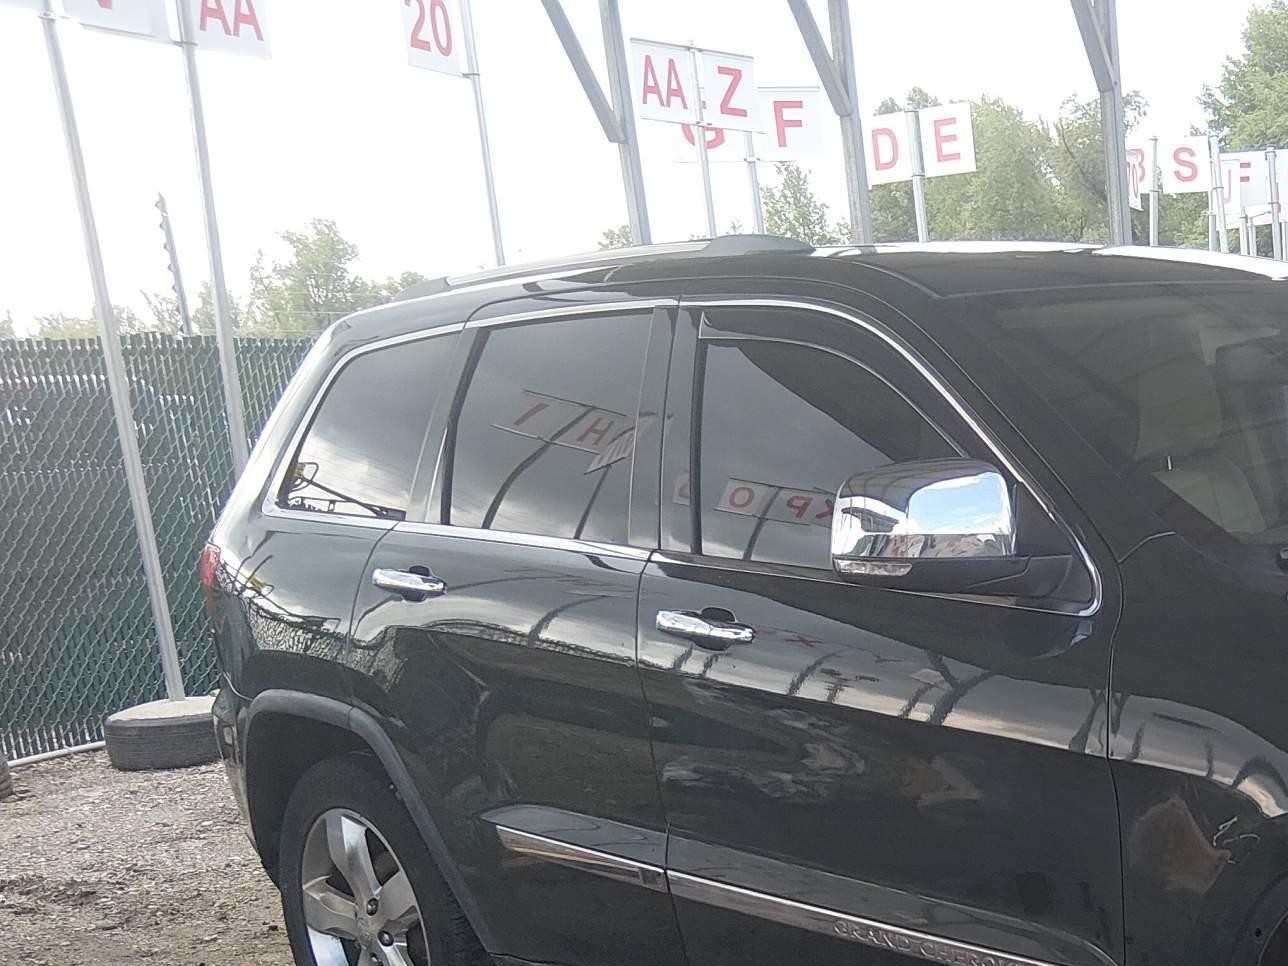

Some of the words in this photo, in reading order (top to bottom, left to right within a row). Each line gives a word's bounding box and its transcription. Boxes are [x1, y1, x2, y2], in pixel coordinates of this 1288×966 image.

[200, 0, 265, 42] AA
[404, 0, 453, 57] 20
[642, 54, 688, 110] AA
[717, 65, 748, 118] Z
[773, 100, 804, 148] F
[933, 117, 962, 163] E
[872, 127, 899, 171] D
[1172, 146, 1199, 183] S
[833, 919, 913, 952] GRAND
